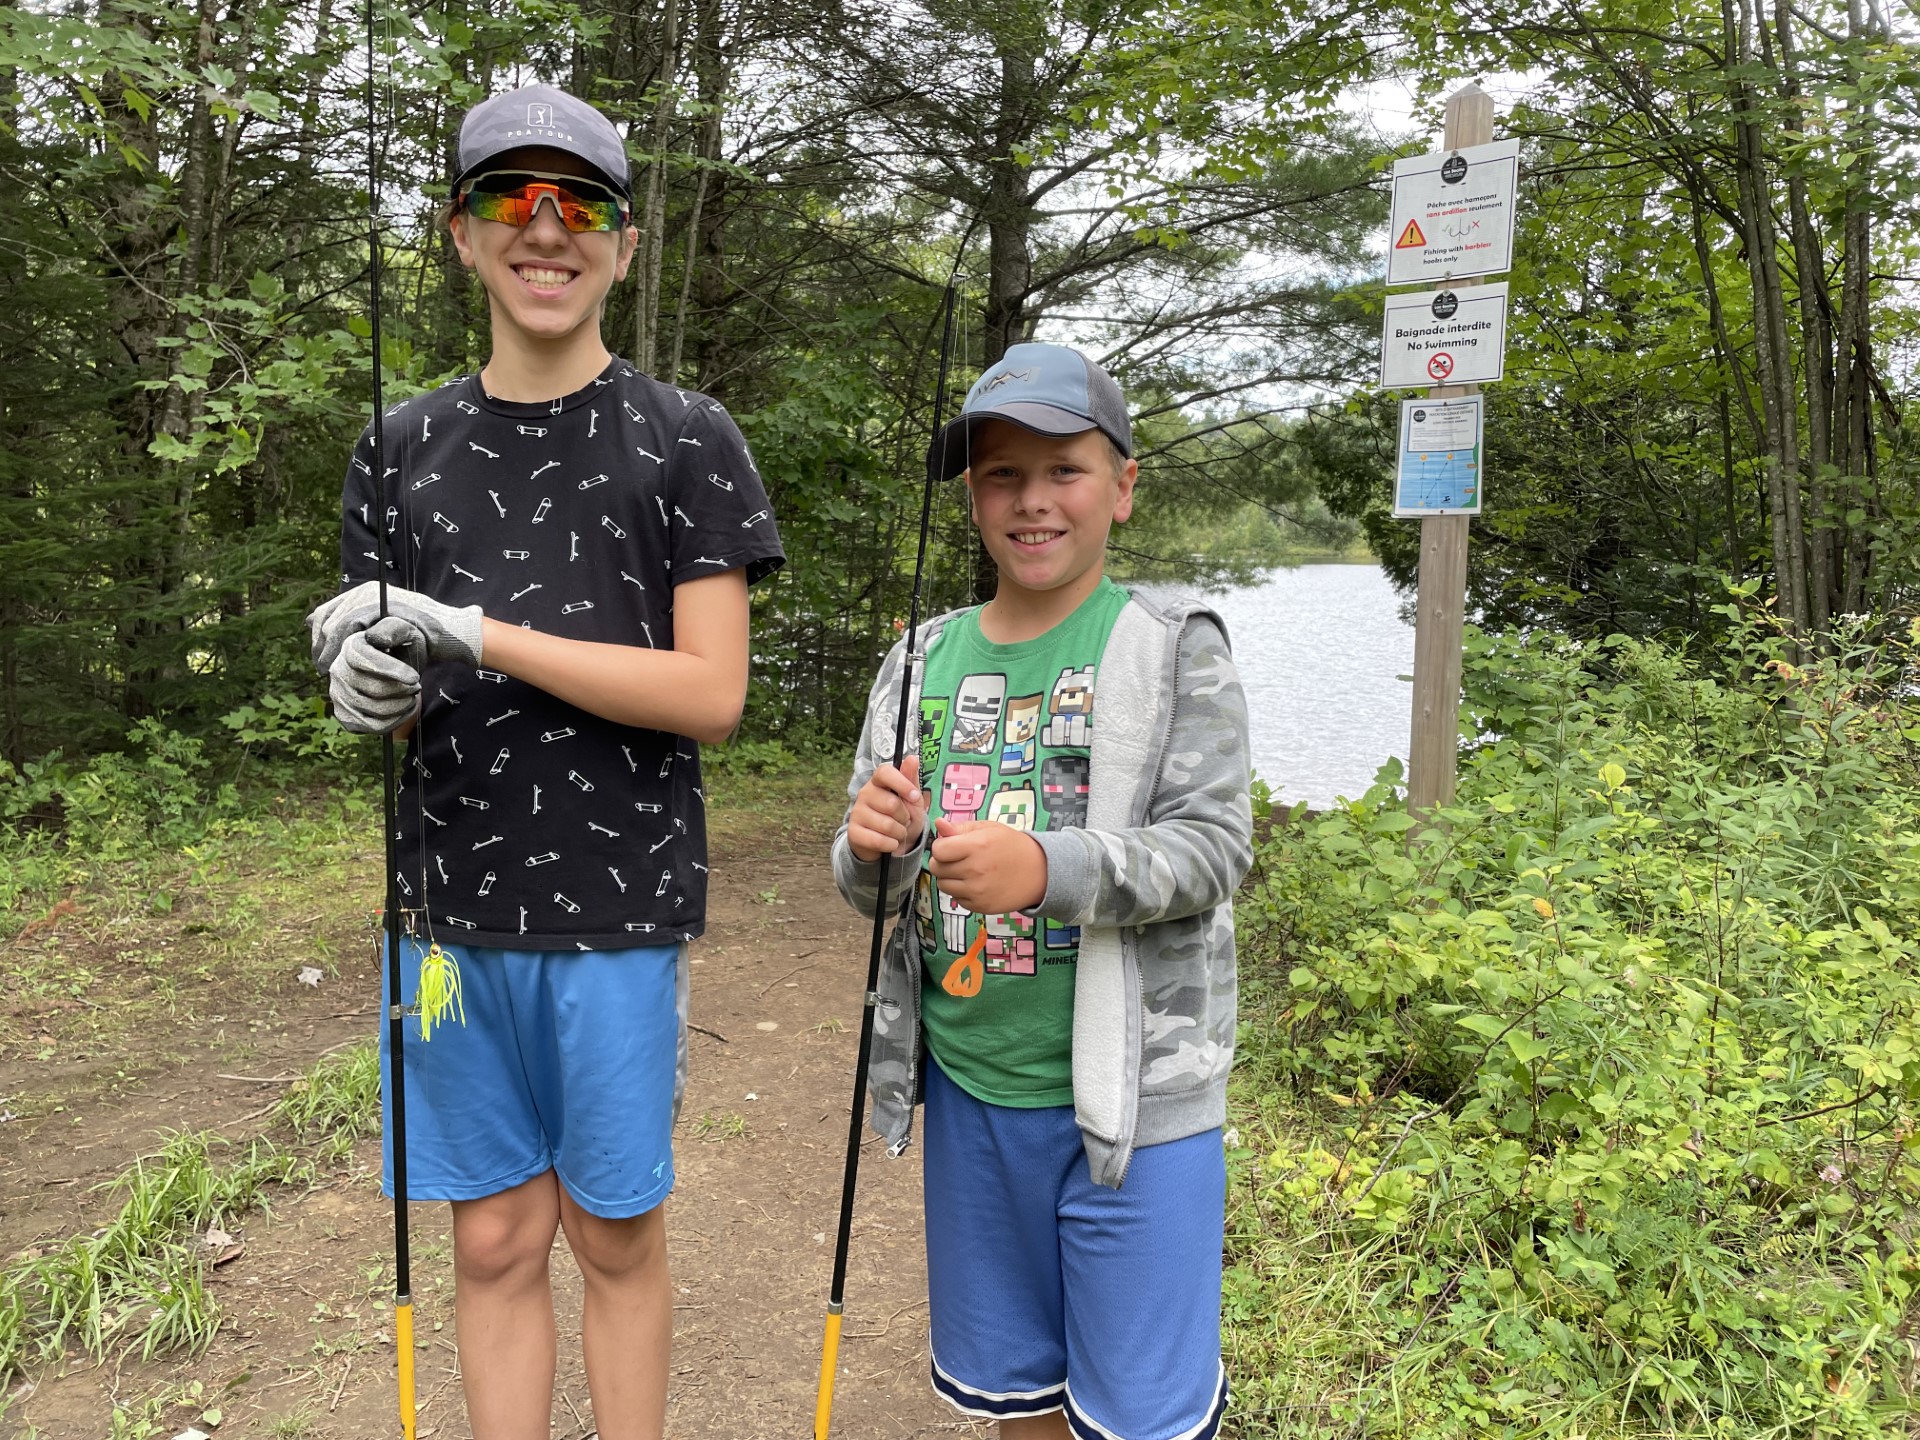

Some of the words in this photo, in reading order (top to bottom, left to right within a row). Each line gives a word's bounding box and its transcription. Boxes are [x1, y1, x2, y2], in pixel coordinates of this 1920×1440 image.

[507, 129, 532, 138] PGA
[538, 129, 573, 142] TOUR
[1441, 207, 1468, 216] ardillon
[1468, 201, 1502, 211] seulement
[1448, 199, 1463, 207] avec
[1423, 247, 1447, 255] Fishing
[1448, 244, 1464, 253] with
[1464, 242, 1491, 250] barbless
[1423, 257, 1443, 265] hooks
[1443, 255, 1458, 263] only
[1396, 325, 1445, 338] Baignade
[1447, 320, 1492, 333] interdite
[1407, 341, 1422, 351] No
[1425, 337, 1477, 349] Swimming
